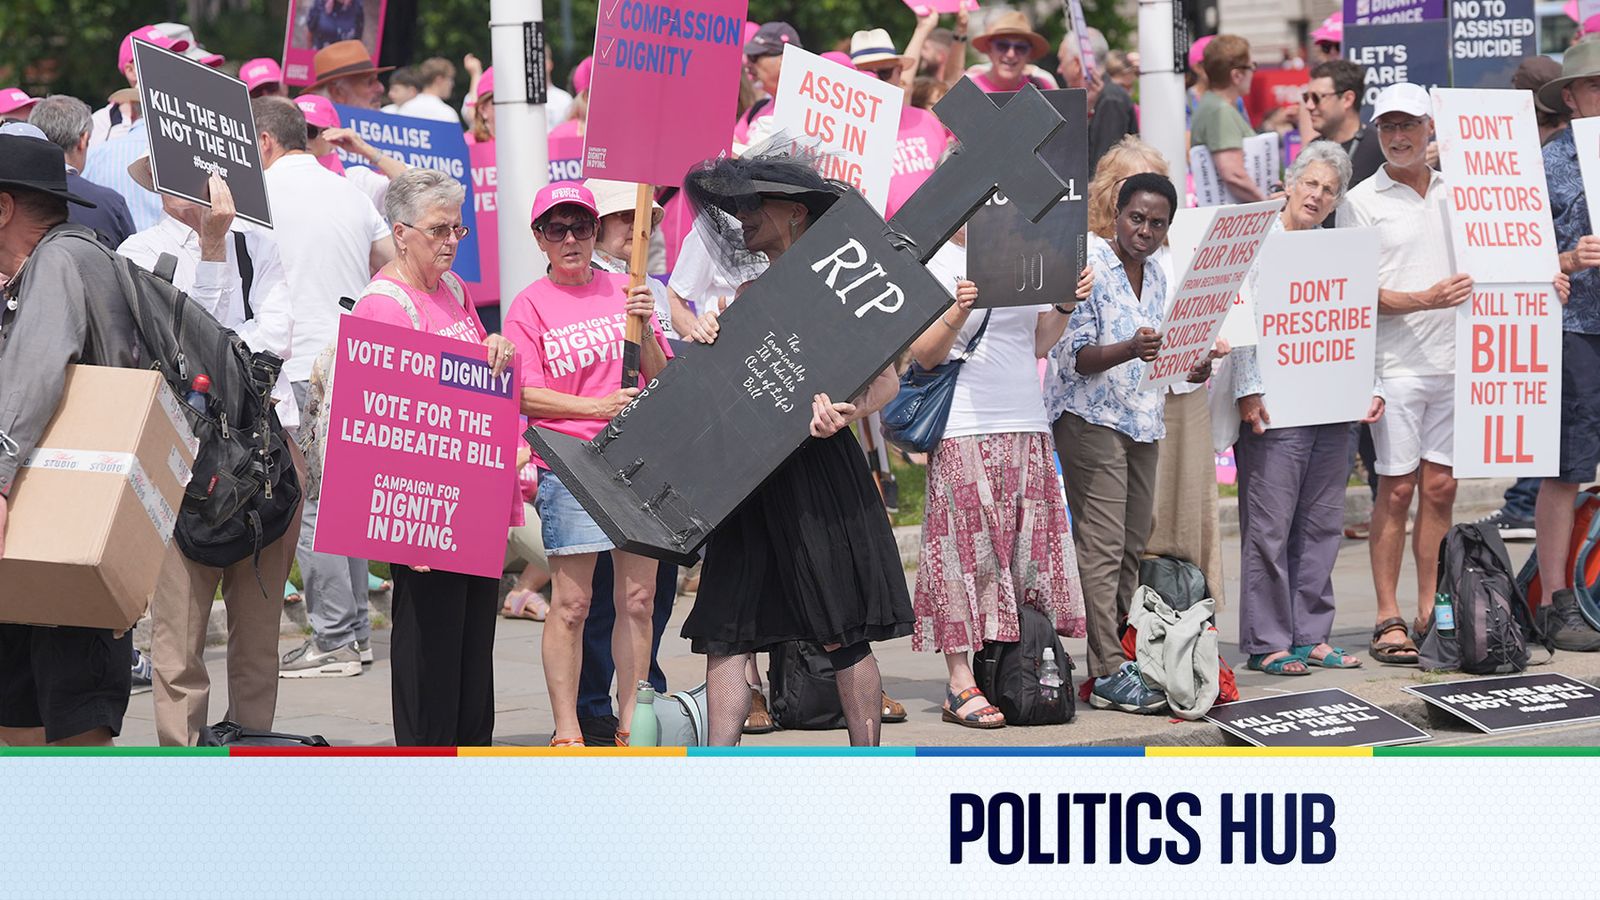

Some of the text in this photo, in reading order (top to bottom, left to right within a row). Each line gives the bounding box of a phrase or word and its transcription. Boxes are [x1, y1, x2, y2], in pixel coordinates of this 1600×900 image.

[620, 0, 740, 46] COMPASSION
[1453, 0, 1506, 19] NO TO
[1454, 19, 1535, 38] ASSISTED
[615, 38, 693, 77] DIGNITY
[1350, 45, 1407, 64] LET'S
[1454, 40, 1523, 58] SUICIDE
[1364, 66, 1408, 84] ARE
[799, 70, 882, 123] ASSIST
[150, 88, 252, 145] KILL THE BILL
[1458, 115, 1513, 140] DON'T
[159, 116, 252, 168] NOT THE ILL
[350, 119, 432, 149] LEGALISE
[804, 108, 866, 156] US IN
[1464, 151, 1521, 176] MAKE
[1453, 186, 1542, 211] DOCTORS
[1208, 210, 1276, 241] PROTECT
[1465, 222, 1542, 246] KILLERS
[1194, 239, 1259, 271] OUR NHS
[811, 238, 904, 318] RIP
[1183, 271, 1245, 291] FROM BECOMING THE
[1290, 278, 1348, 304] DON'T
[1168, 290, 1233, 322] NATIONAL
[1472, 292, 1548, 316] KILL THE
[543, 313, 627, 340] CAMPAIGN FO
[1162, 319, 1216, 350] SUICIDE
[1263, 306, 1371, 336] PRESCRIBE
[544, 322, 626, 360] DIGNIT
[787, 332, 800, 353] The
[1278, 338, 1355, 366] SUICIDE
[1472, 324, 1548, 373] BILL
[347, 338, 511, 394] VOTE FOR DIGNITY
[548, 340, 624, 378] IN DYI
[756, 344, 795, 392] Ill Adults
[764, 331, 805, 382] Terminally
[1150, 348, 1204, 380] SERVICE
[743, 376, 763, 400] Bill
[745, 356, 794, 412] (End of Life)
[1471, 381, 1547, 405] NOT THE
[364, 390, 492, 437] VOTE FOR THE
[340, 418, 505, 469] LEADBEATER BILL
[1484, 415, 1534, 464] ILL
[44, 460, 77, 468] STUDIO
[90, 463, 123, 472] STUDIO
[374, 474, 460, 500] CAMPAIGN FOR
[370, 489, 458, 525] DIGNITY
[367, 515, 457, 552] IN DYING.
[1441, 682, 1585, 704] KILL THE BILL
[1463, 690, 1594, 711] NOT THE ILL
[1230, 702, 1370, 729] KILL THE BILL
[1253, 712, 1380, 736] NOT THE ILL
